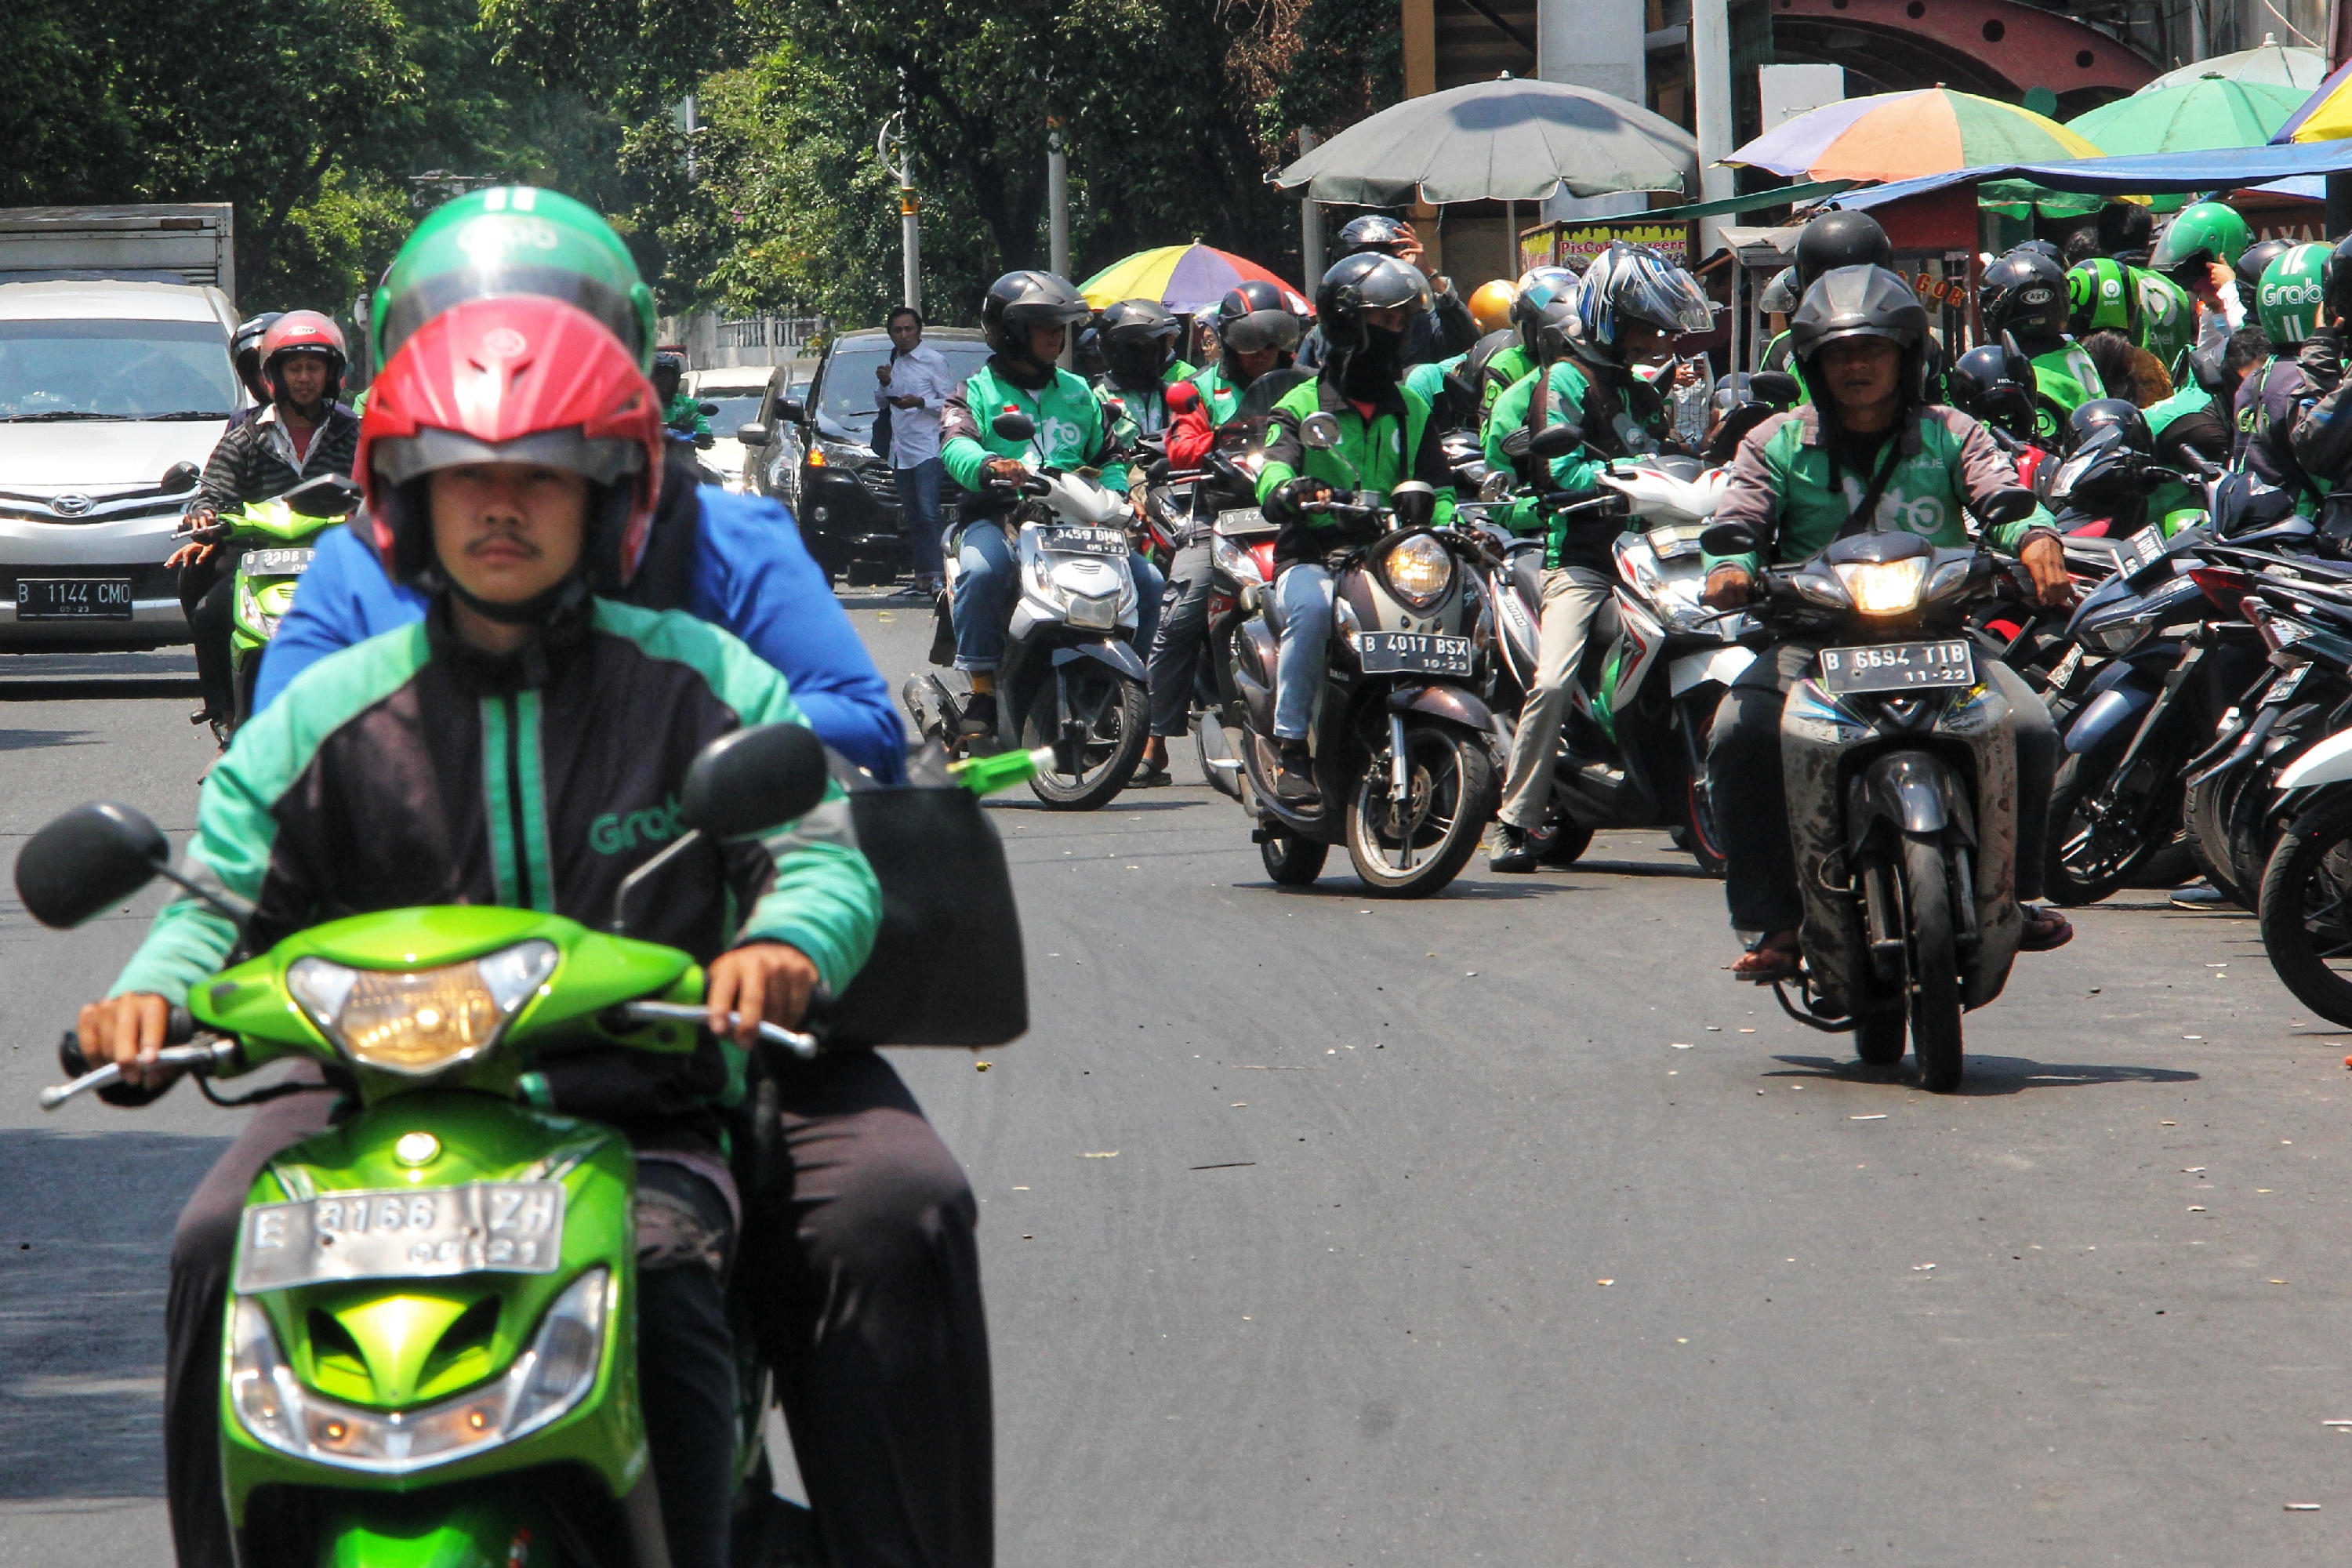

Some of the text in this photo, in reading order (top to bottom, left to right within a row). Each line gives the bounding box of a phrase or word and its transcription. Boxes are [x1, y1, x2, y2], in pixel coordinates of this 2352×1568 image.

[2262, 277, 2323, 306] Grab
[18, 583, 29, 603] B
[49, 583, 88, 603] 1144
[1364, 634, 1467, 656] B 4017 BSX
[1825, 644, 1965, 670] B 6694 TIB
[253, 1209, 285, 1250] E
[488, 1188, 555, 1231] ZH
